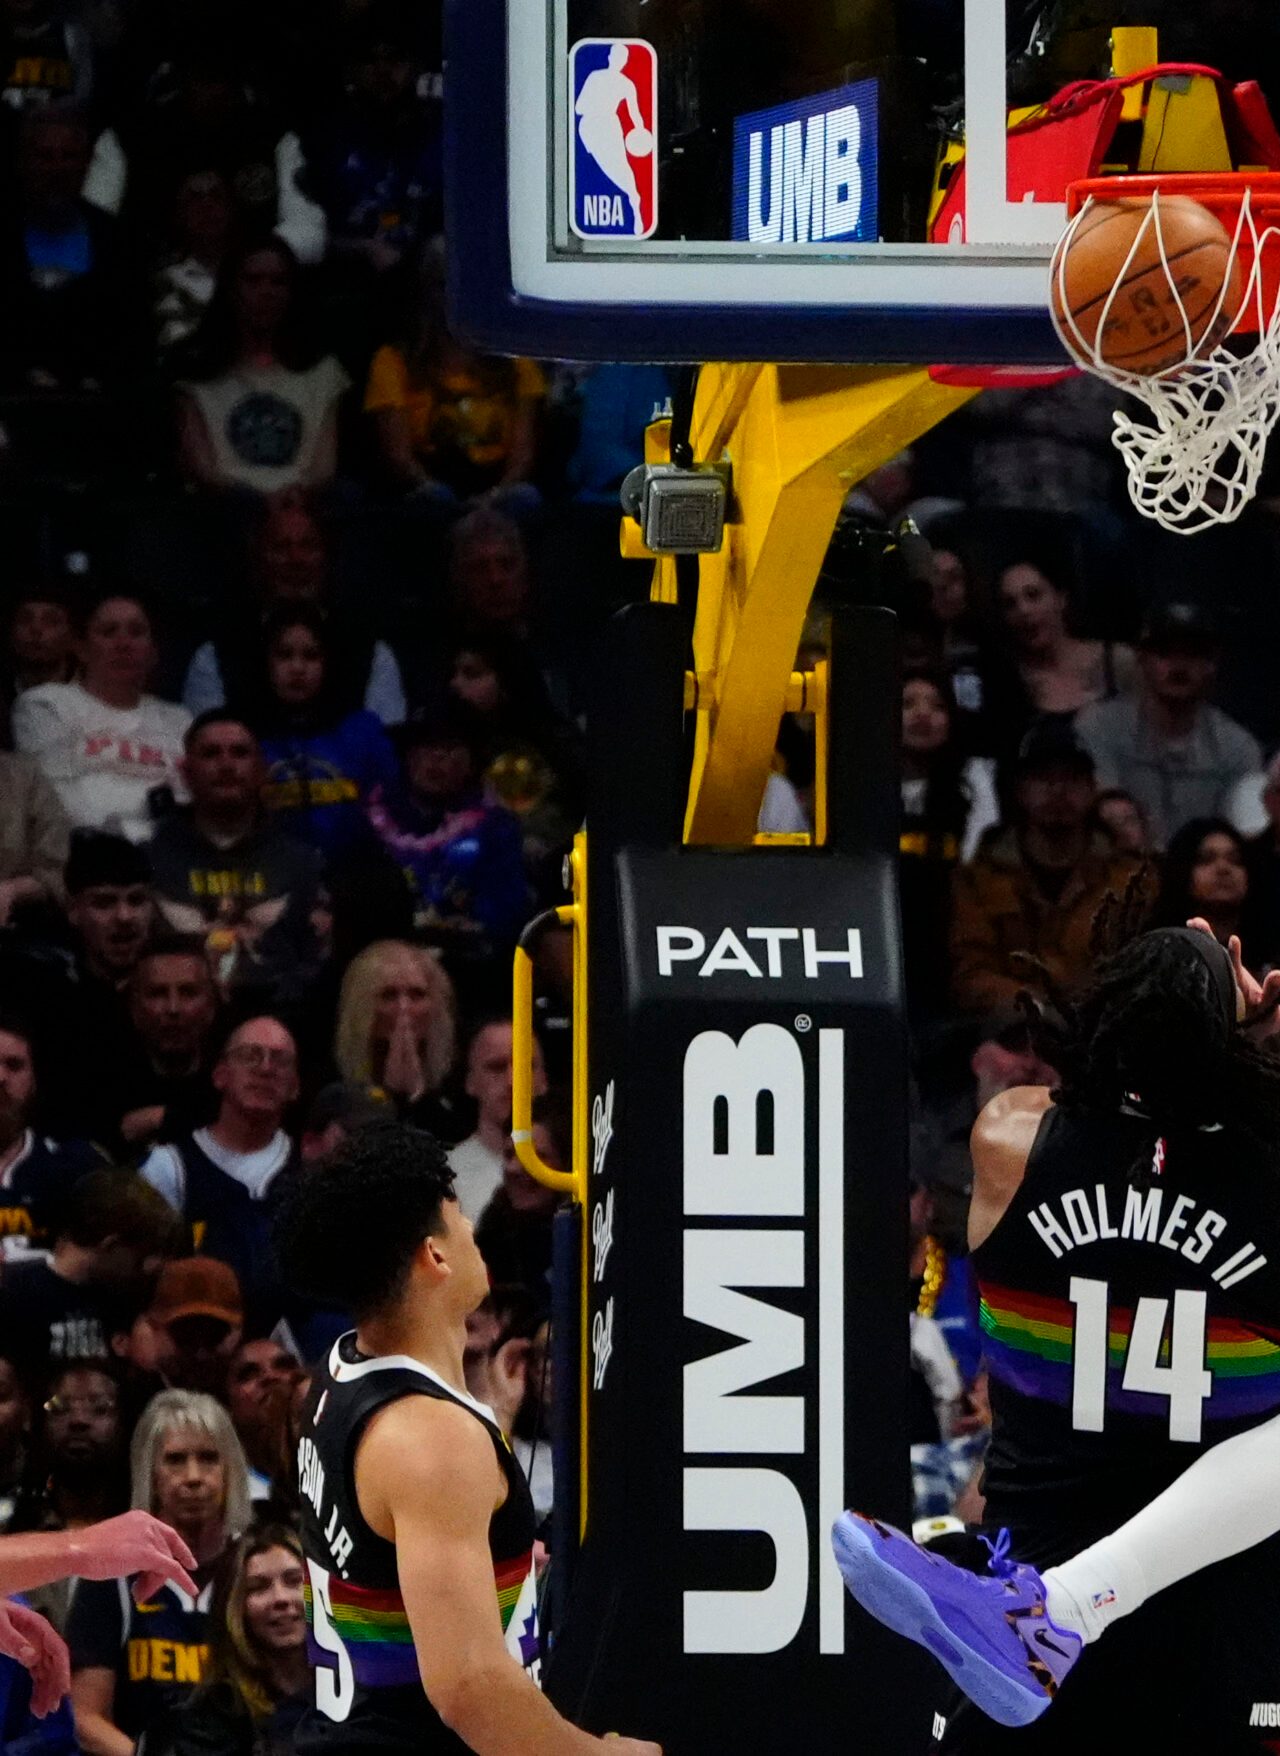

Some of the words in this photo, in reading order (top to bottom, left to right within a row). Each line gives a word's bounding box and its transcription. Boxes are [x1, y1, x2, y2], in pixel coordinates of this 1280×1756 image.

[583, 194, 625, 228] NBA
[748, 105, 862, 243] UMB
[656, 925, 864, 979] PATH
[1027, 1183, 1227, 1264] HOLMES
[1211, 1241, 1268, 1290] II
[1069, 1276, 1212, 1443] 14
